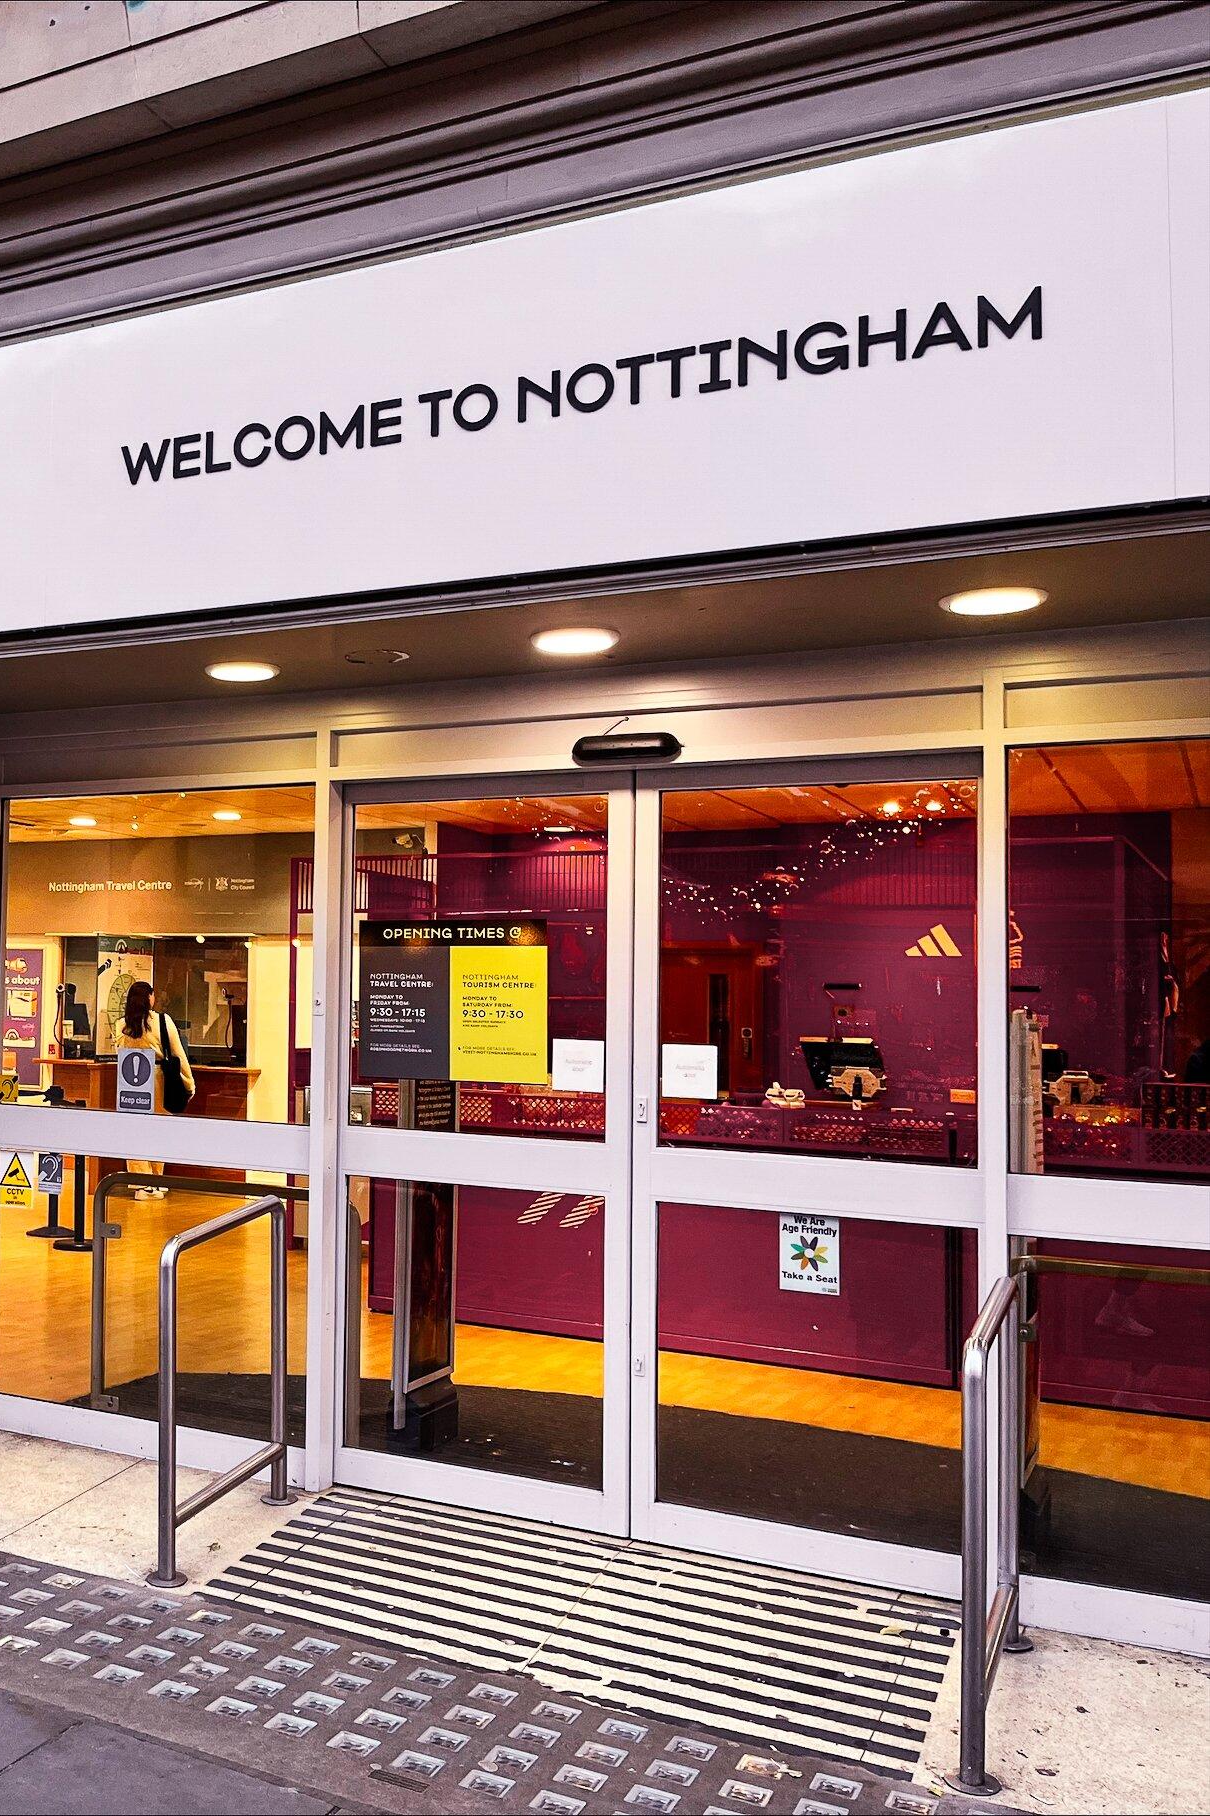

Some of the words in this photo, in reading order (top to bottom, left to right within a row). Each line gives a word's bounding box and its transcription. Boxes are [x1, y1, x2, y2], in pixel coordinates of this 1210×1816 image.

[121, 398, 402, 485] WELCOME
[418, 383, 499, 437] TO
[517, 286, 1043, 423] NOTTINGHAM
[48, 881, 105, 894] Nottingham
[106, 880, 136, 891] Travel
[138, 879, 172, 891] Centre
[383, 928, 452, 939] OPENING
[457, 927, 505, 939] TIMES
[11, 974, 40, 985] about
[370, 1007, 393, 1017] 9:30
[401, 1008, 426, 1017] 17:15
[462, 1009, 486, 1018] 9:30
[496, 1010, 524, 1019] 17:30
[120, 1096, 135, 1105] Keep
[136, 1097, 150, 1105] clear
[793, 1215, 807, 1224] We
[810, 1216, 825, 1226] Are
[782, 1223, 799, 1234] Age
[801, 1225, 837, 1237] Friendly
[782, 1270, 804, 1280] Take
[815, 1274, 838, 1284] Seat
